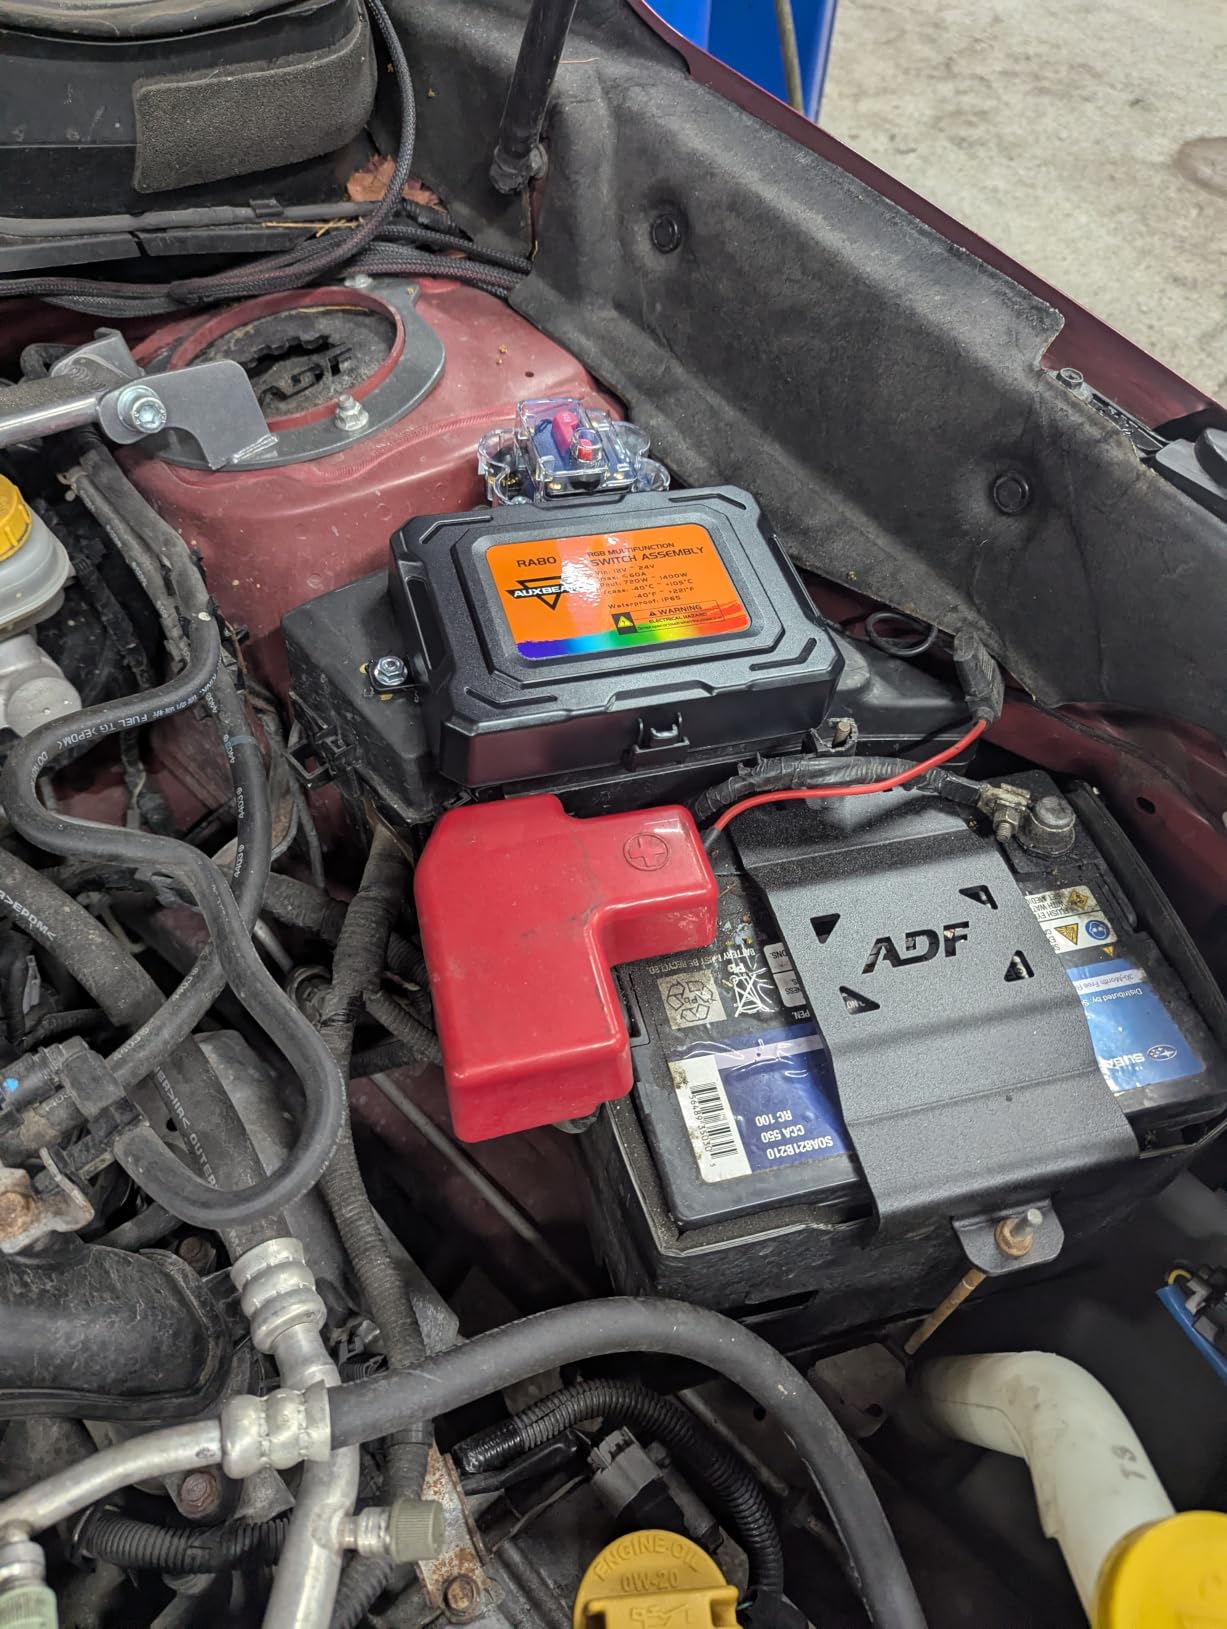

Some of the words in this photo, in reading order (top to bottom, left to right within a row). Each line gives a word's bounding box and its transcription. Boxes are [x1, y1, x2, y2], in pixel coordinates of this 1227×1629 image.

[608, 542, 674, 554] MULTIFUNCTION
[591, 556, 637, 567] SWITCH
[642, 546, 704, 561] ASSEMBLY
[624, 577, 648, 585] 720W
[660, 572, 688, 580] 1400W
[662, 595, 681, 603] IP65
[658, 604, 702, 616] WARNING
[118, 713, 148, 728] FUEL
[236, 795, 245, 818] 4403
[234, 852, 244, 878] 4403
[862, 920, 970, 975] ADF
[723, 948, 756, 961] BATTERY
[688, 959, 699, 968] BE
[727, 963, 746, 973] Pb
[684, 996, 698, 1004] Pb
[1102, 988, 1143, 1002] Distributed
[756, 1114, 775, 1126] 100
[776, 1110, 792, 1122] RC
[761, 1130, 781, 1143] 550
[782, 1124, 804, 1136] CCA
[620, 1568, 680, 1592] 0W-20
